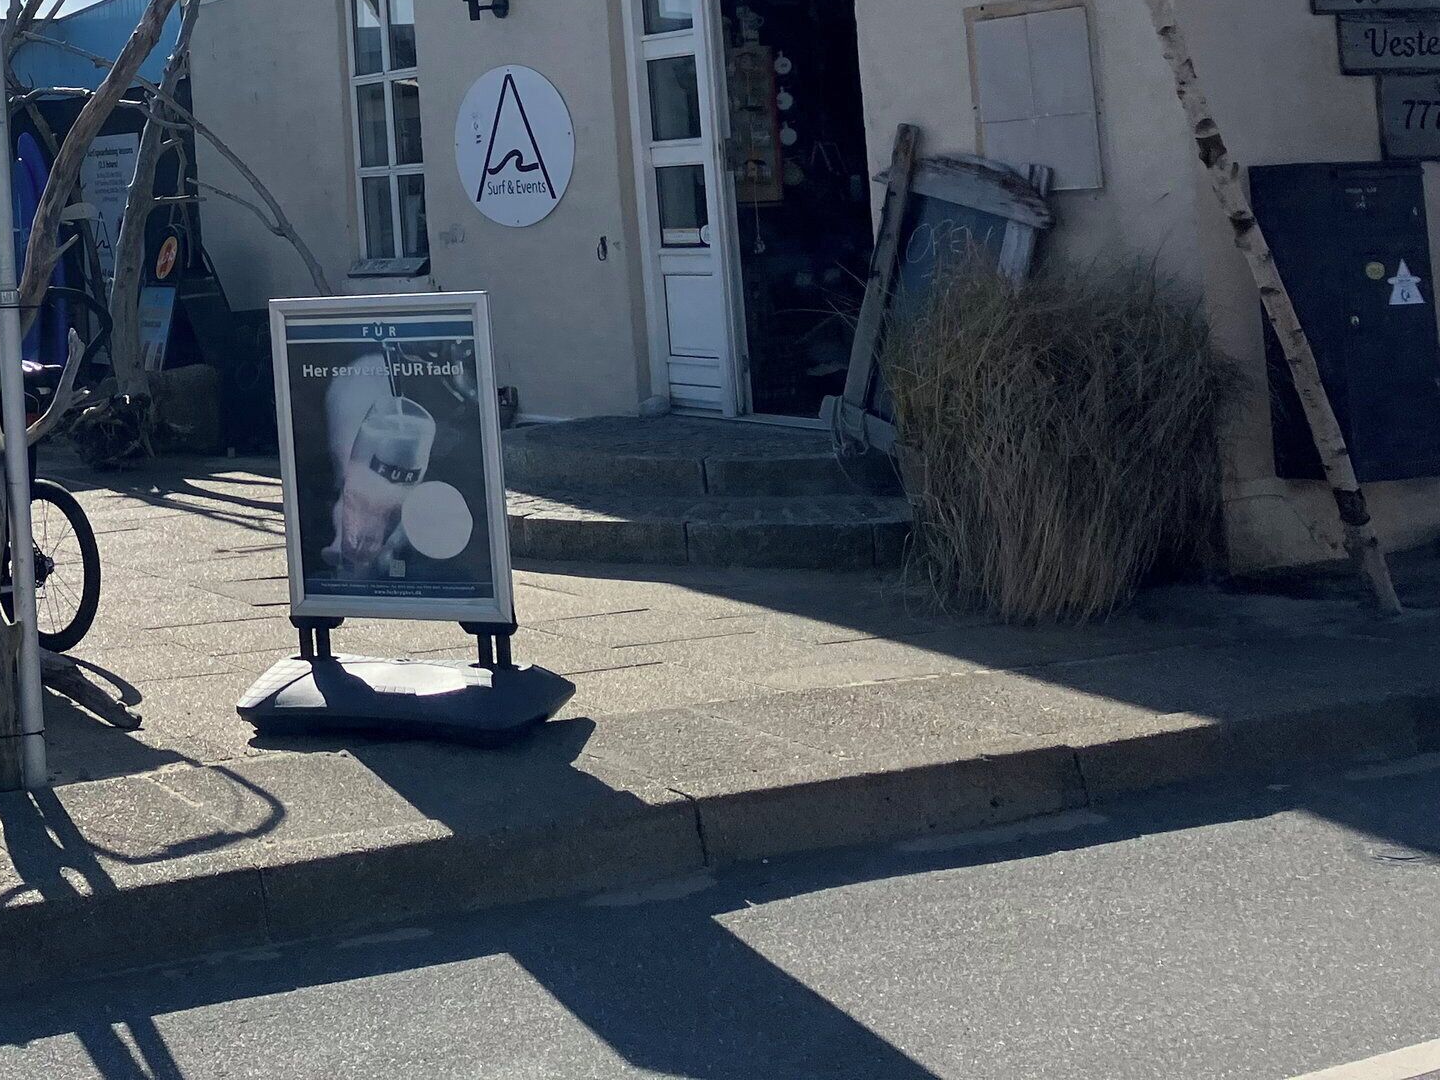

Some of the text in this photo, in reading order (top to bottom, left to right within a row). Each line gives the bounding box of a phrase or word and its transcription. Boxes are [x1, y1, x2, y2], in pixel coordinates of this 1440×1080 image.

[487, 178, 547, 196] Surf & Events
[362, 325, 397, 337] FUR
[302, 364, 328, 378] Her
[331, 364, 390, 377] serveres
[393, 362, 423, 377] FUR
[378, 464, 414, 482] FUR
